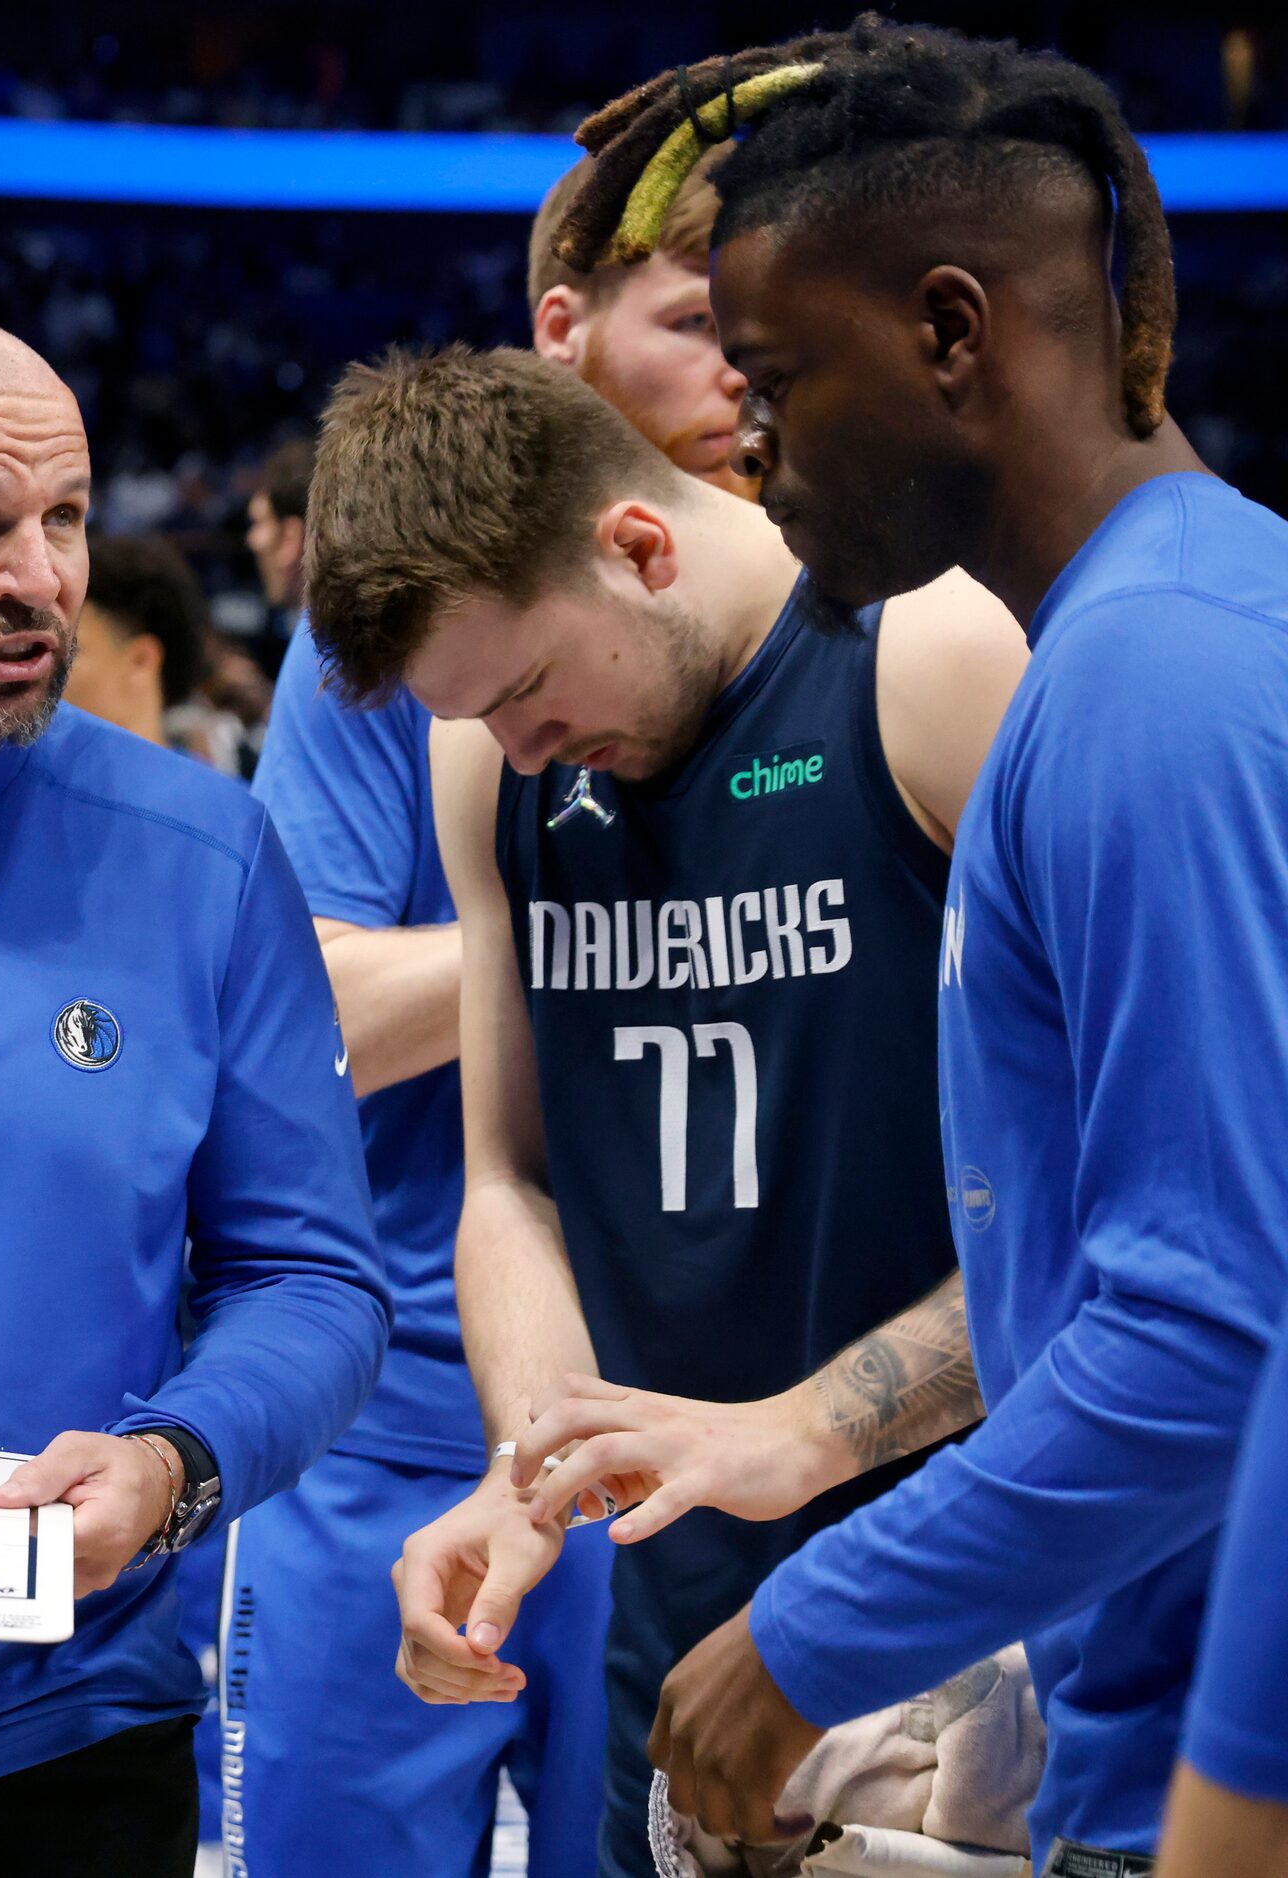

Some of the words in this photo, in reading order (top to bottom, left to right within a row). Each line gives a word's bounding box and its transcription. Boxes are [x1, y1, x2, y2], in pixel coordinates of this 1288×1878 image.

[729, 752, 824, 801] chime
[529, 877, 853, 990] MAVERICKS
[938, 884, 966, 992] N
[613, 1021, 760, 1212] 77
